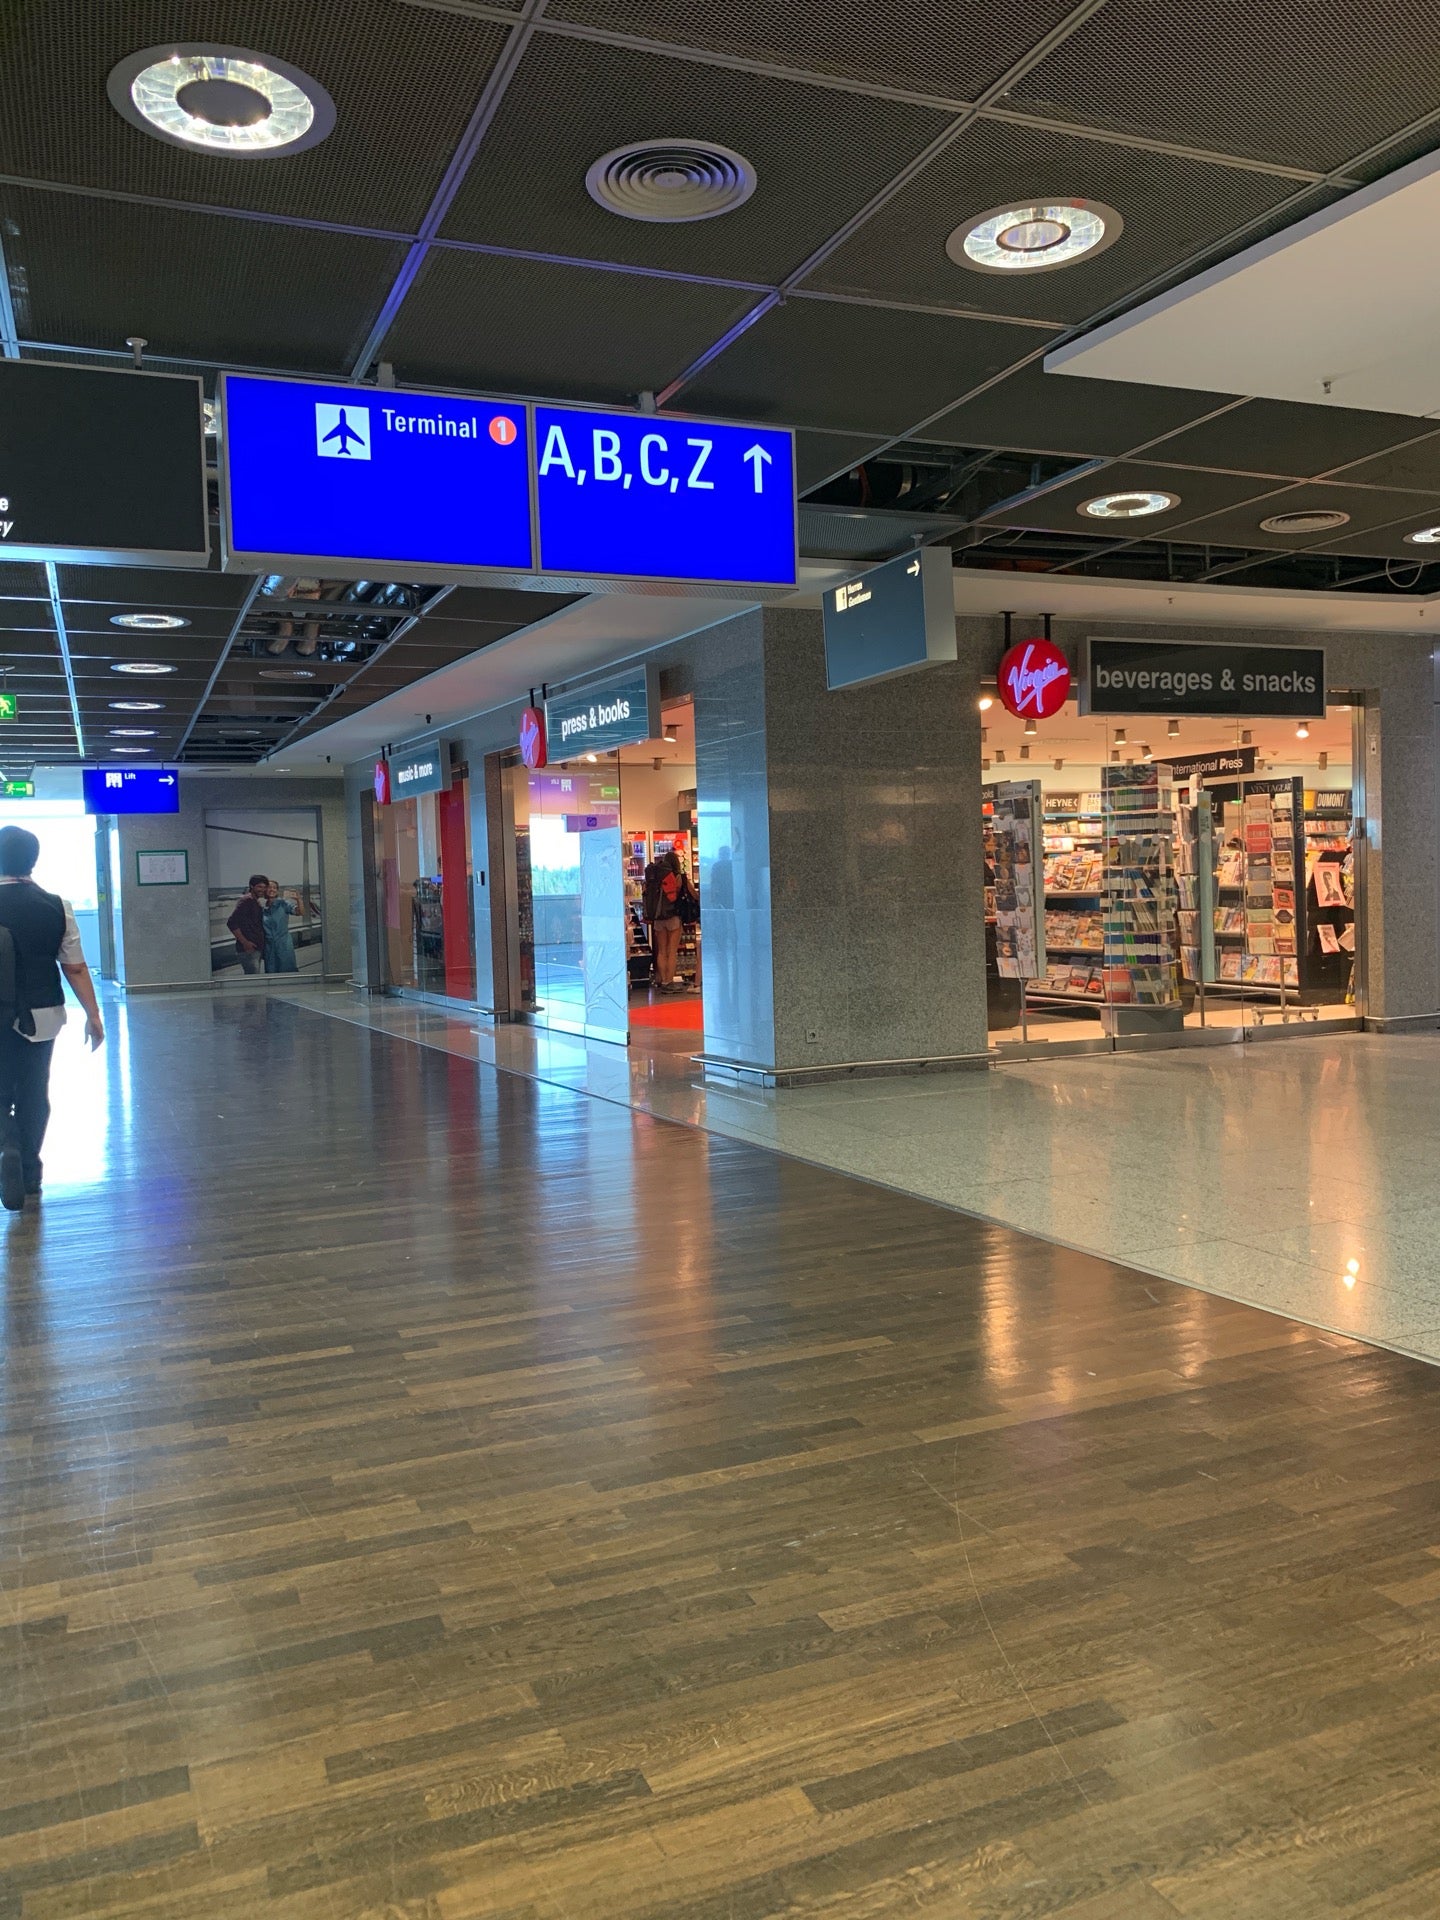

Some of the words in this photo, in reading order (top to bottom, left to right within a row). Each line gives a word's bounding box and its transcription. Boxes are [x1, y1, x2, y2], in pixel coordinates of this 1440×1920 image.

[381, 408, 477, 438] Terminal
[497, 420, 507, 441] 1
[1007, 644, 1068, 713] Virgin
[1096, 664, 1213, 696] beverages
[1220, 668, 1236, 691] &
[1242, 671, 1316, 693] snacks
[561, 714, 588, 742] press
[589, 707, 597, 729] &
[598, 698, 630, 726] books
[124, 772, 136, 780] Lift
[398, 765, 414, 784] music
[418, 762, 433, 778] more
[1172, 759, 1217, 775] nternational
[1219, 758, 1243, 770] Press
[1045, 798, 1073, 808] HEYNE
[1317, 793, 1346, 807] DUMONT
